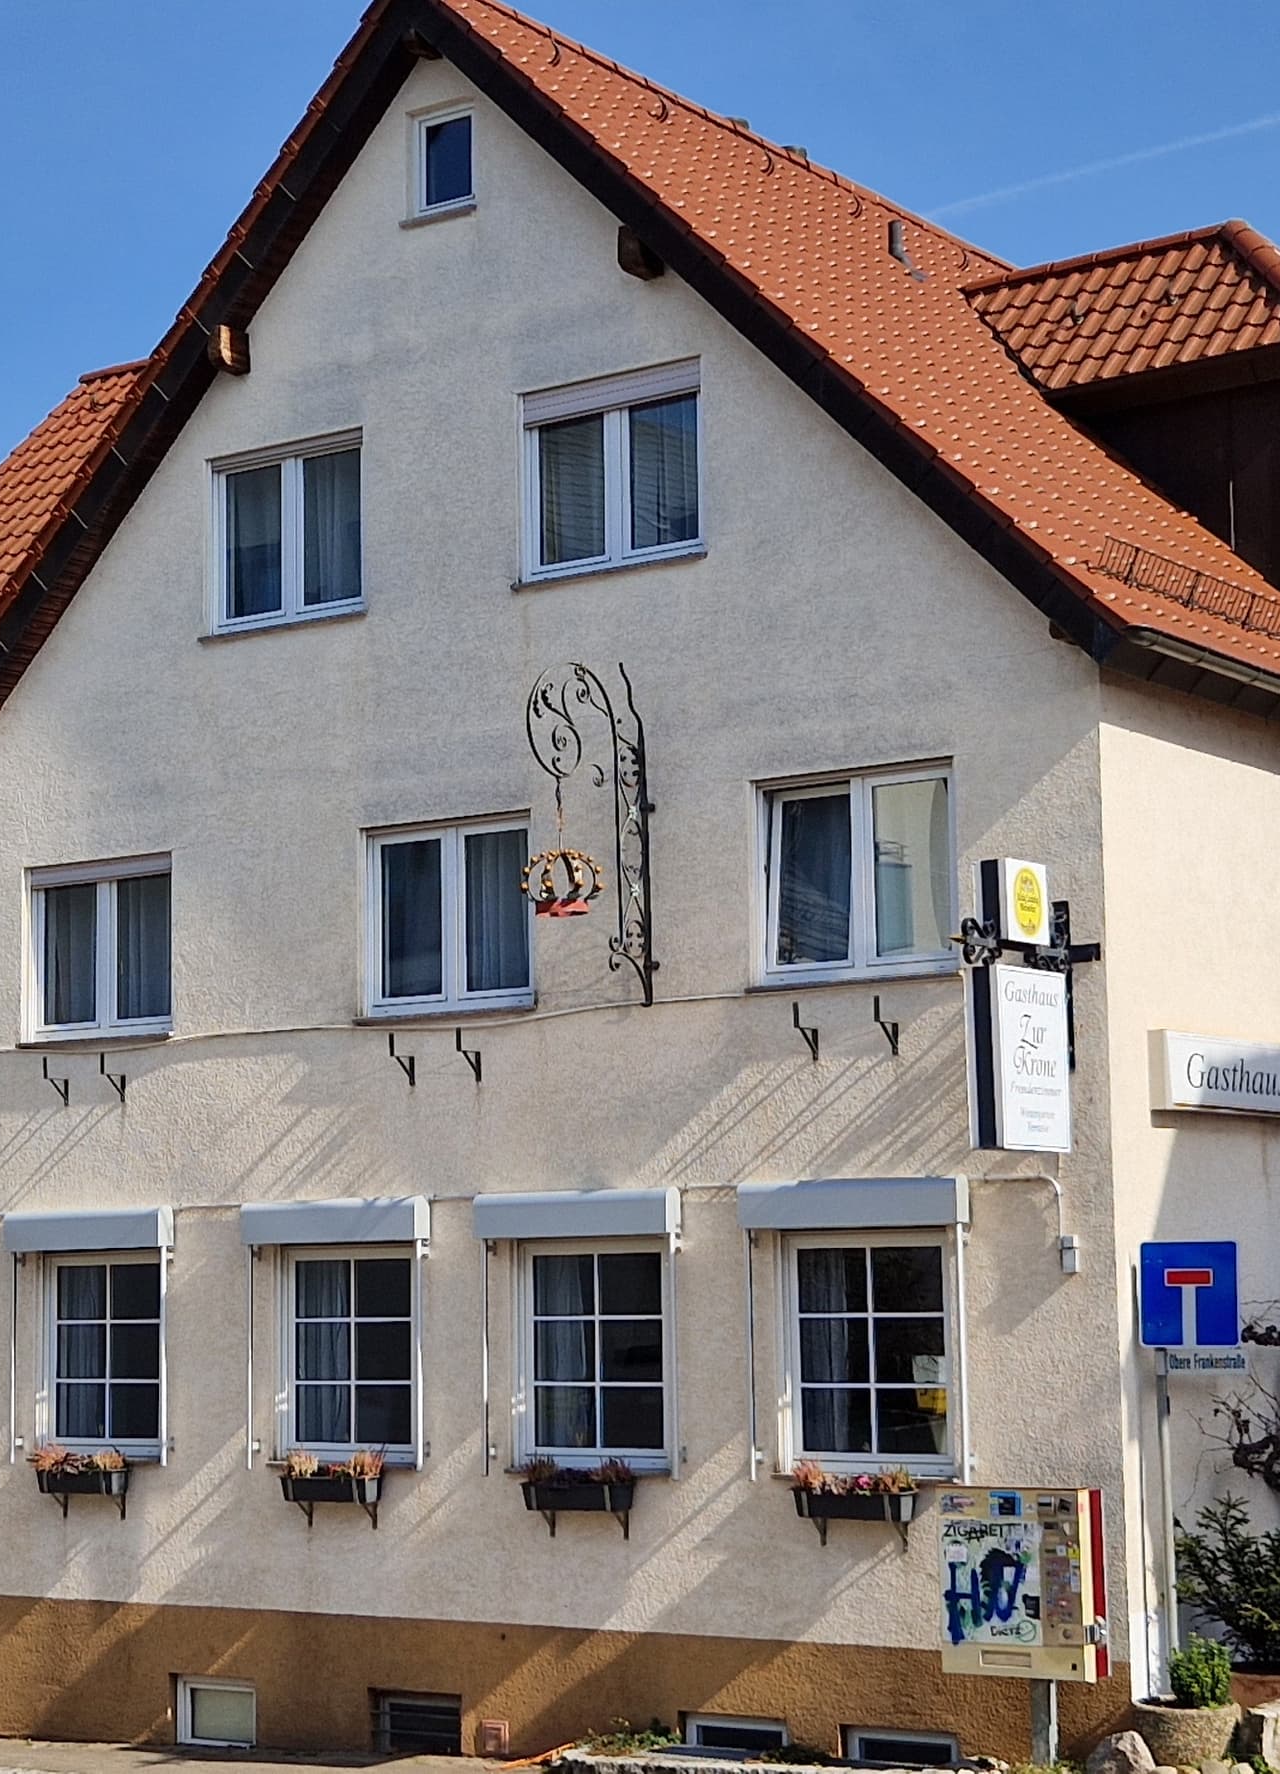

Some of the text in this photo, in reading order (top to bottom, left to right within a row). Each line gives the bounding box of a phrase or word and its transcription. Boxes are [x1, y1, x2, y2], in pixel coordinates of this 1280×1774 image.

[1005, 981, 1059, 1007] Gasthaus
[1020, 1014, 1047, 1049] Zur
[1013, 1046, 1057, 1078] Krone
[1169, 1353, 1245, 1369] Obere Frankenstraße
